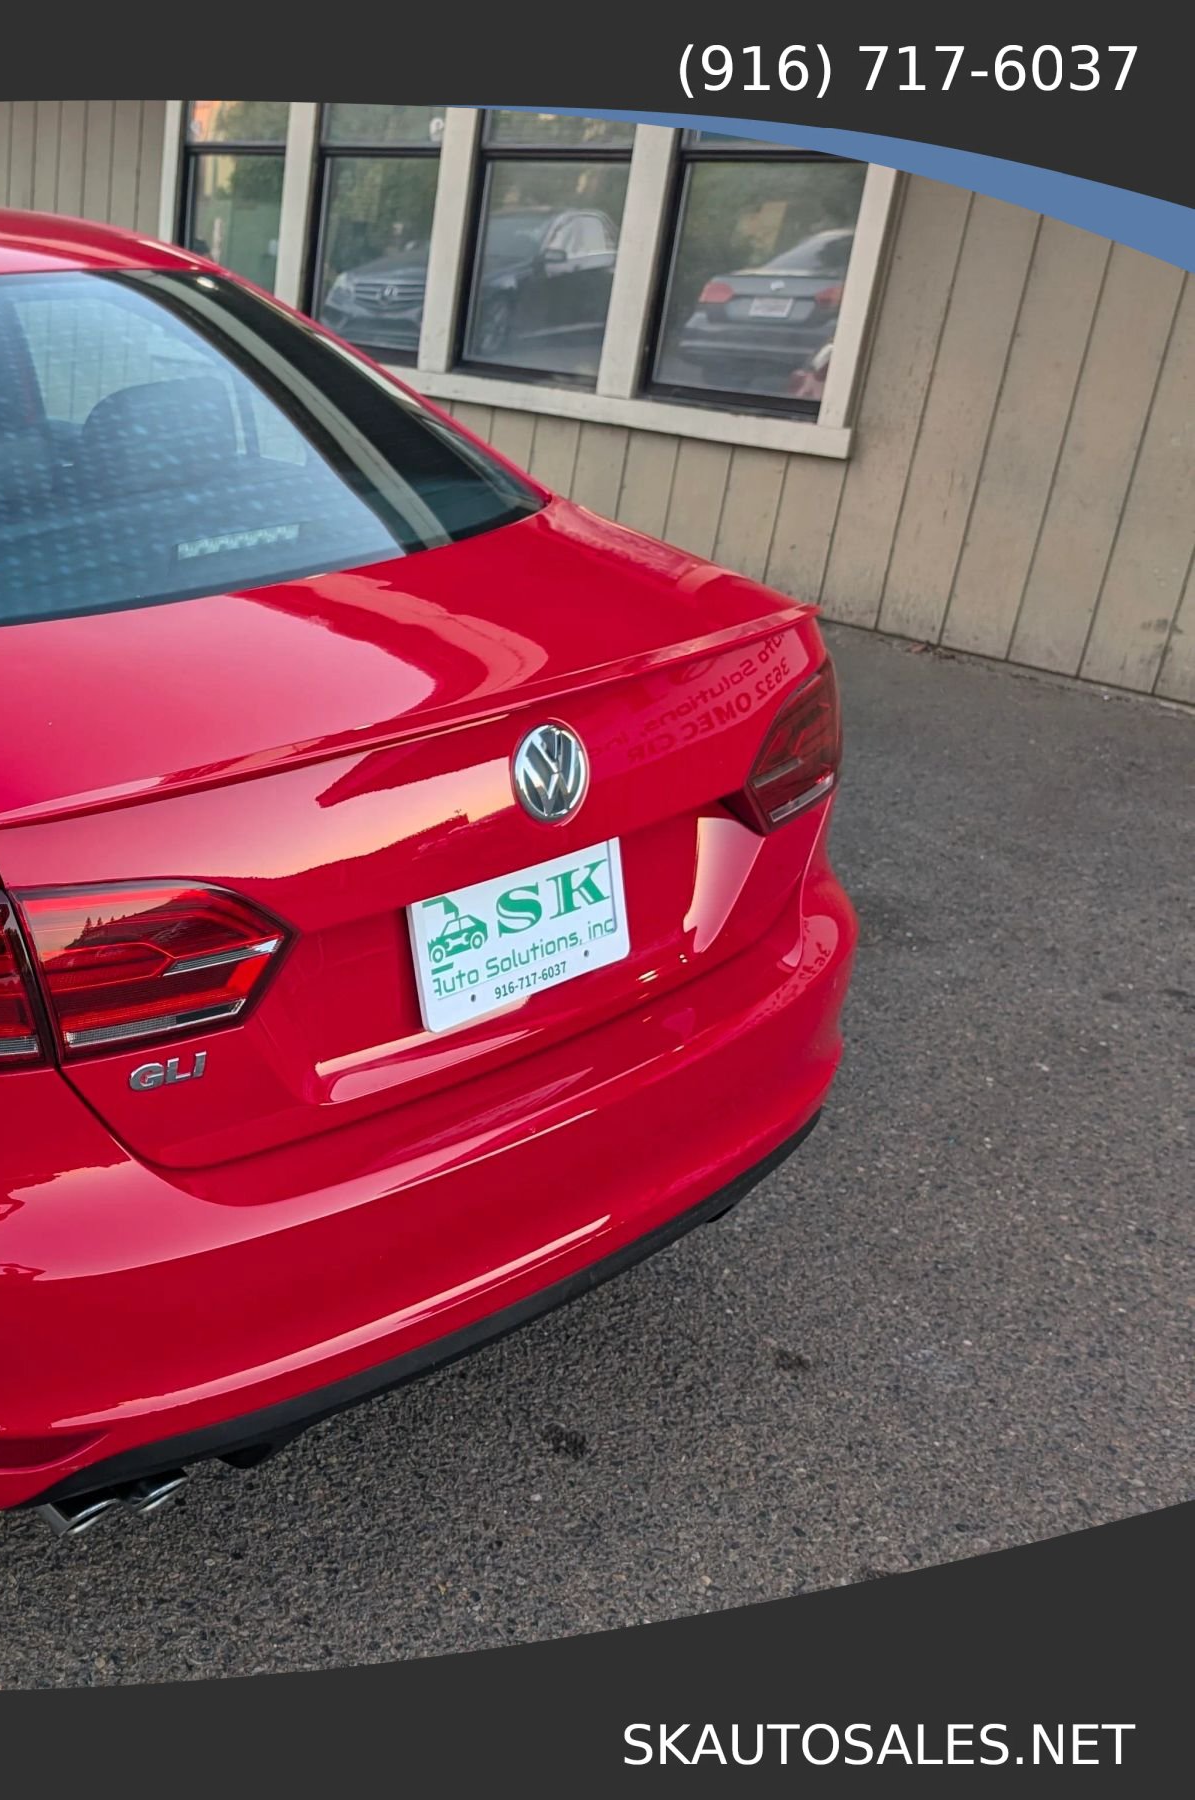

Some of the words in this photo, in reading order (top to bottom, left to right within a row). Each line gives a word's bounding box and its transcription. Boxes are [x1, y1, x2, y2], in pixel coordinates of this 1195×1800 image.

[496, 858, 610, 938] SK
[486, 930, 583, 979] Solutions,
[587, 917, 614, 940] inc
[494, 960, 568, 1000] 916-717-6037
[129, 1051, 207, 1091] GLI
